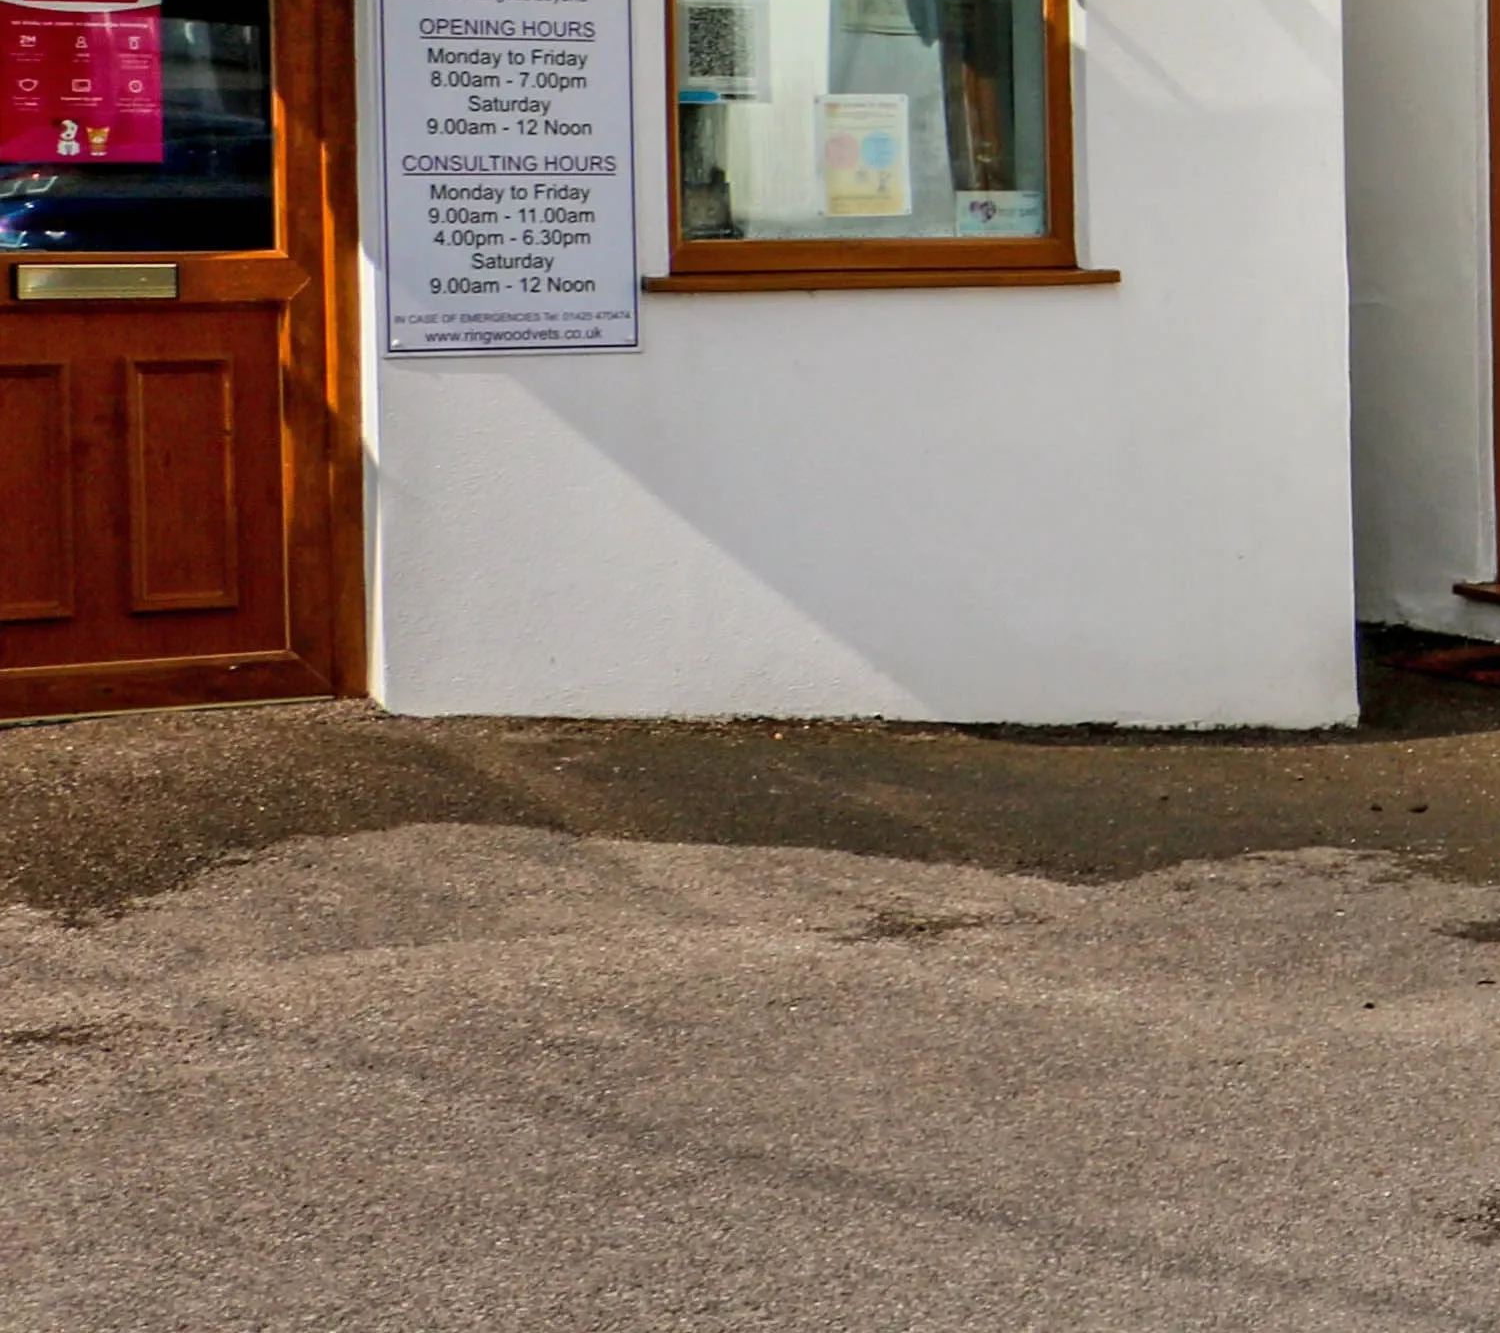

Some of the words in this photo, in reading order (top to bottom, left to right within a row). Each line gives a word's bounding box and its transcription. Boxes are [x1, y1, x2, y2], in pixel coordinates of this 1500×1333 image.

[419, 18, 516, 36] OPENING
[522, 20, 596, 38] HOURS
[427, 48, 502, 68] Monday
[508, 50, 525, 65] to
[531, 49, 588, 70] Friday
[430, 71, 500, 88] 8.00am
[520, 73, 587, 91] 7.00pm
[468, 96, 551, 116] Saturday
[426, 118, 496, 135] 9.00am
[517, 120, 538, 135] 12
[544, 120, 592, 136] Noon
[402, 155, 538, 172] CONSULTING
[544, 156, 617, 172] HOURS
[430, 185, 504, 203] Monday
[511, 185, 528, 200] to
[534, 184, 591, 204] Friday
[428, 208, 498, 224] 9.00am
[519, 207, 595, 224] 11.00am
[434, 231, 504, 249] 4.00pm
[522, 229, 591, 248] 6.30pm
[471, 253, 554, 273] Saturday
[429, 278, 499, 294] 9.00am
[520, 277, 541, 293] 12
[547, 277, 595, 293] Noon
[425, 327, 602, 344] www.ringwoodvets.co.uk
